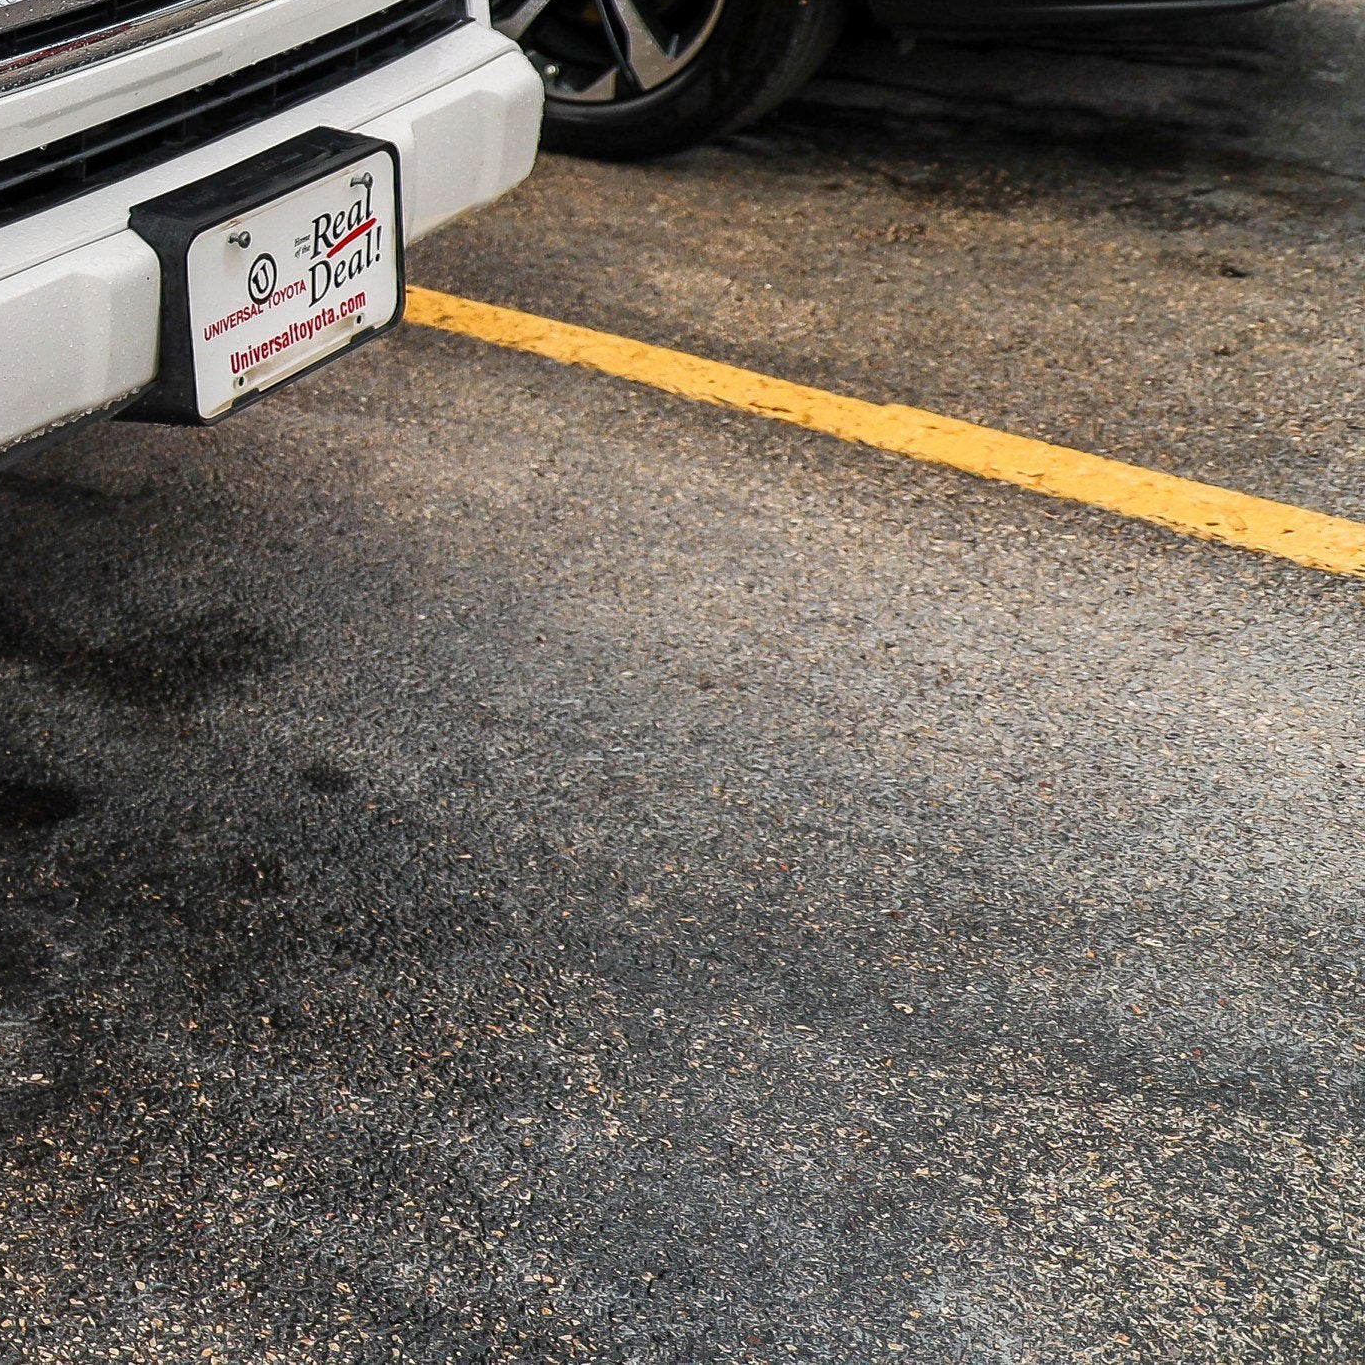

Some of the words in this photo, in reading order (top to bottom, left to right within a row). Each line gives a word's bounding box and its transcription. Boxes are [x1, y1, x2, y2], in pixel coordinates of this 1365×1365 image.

[310, 188, 373, 260] Real
[309, 225, 382, 308] Deal!
[204, 301, 264, 341] UNIVERSAL
[266, 279, 307, 309] TOYOTA
[230, 291, 366, 375] Universaltoyota.com
